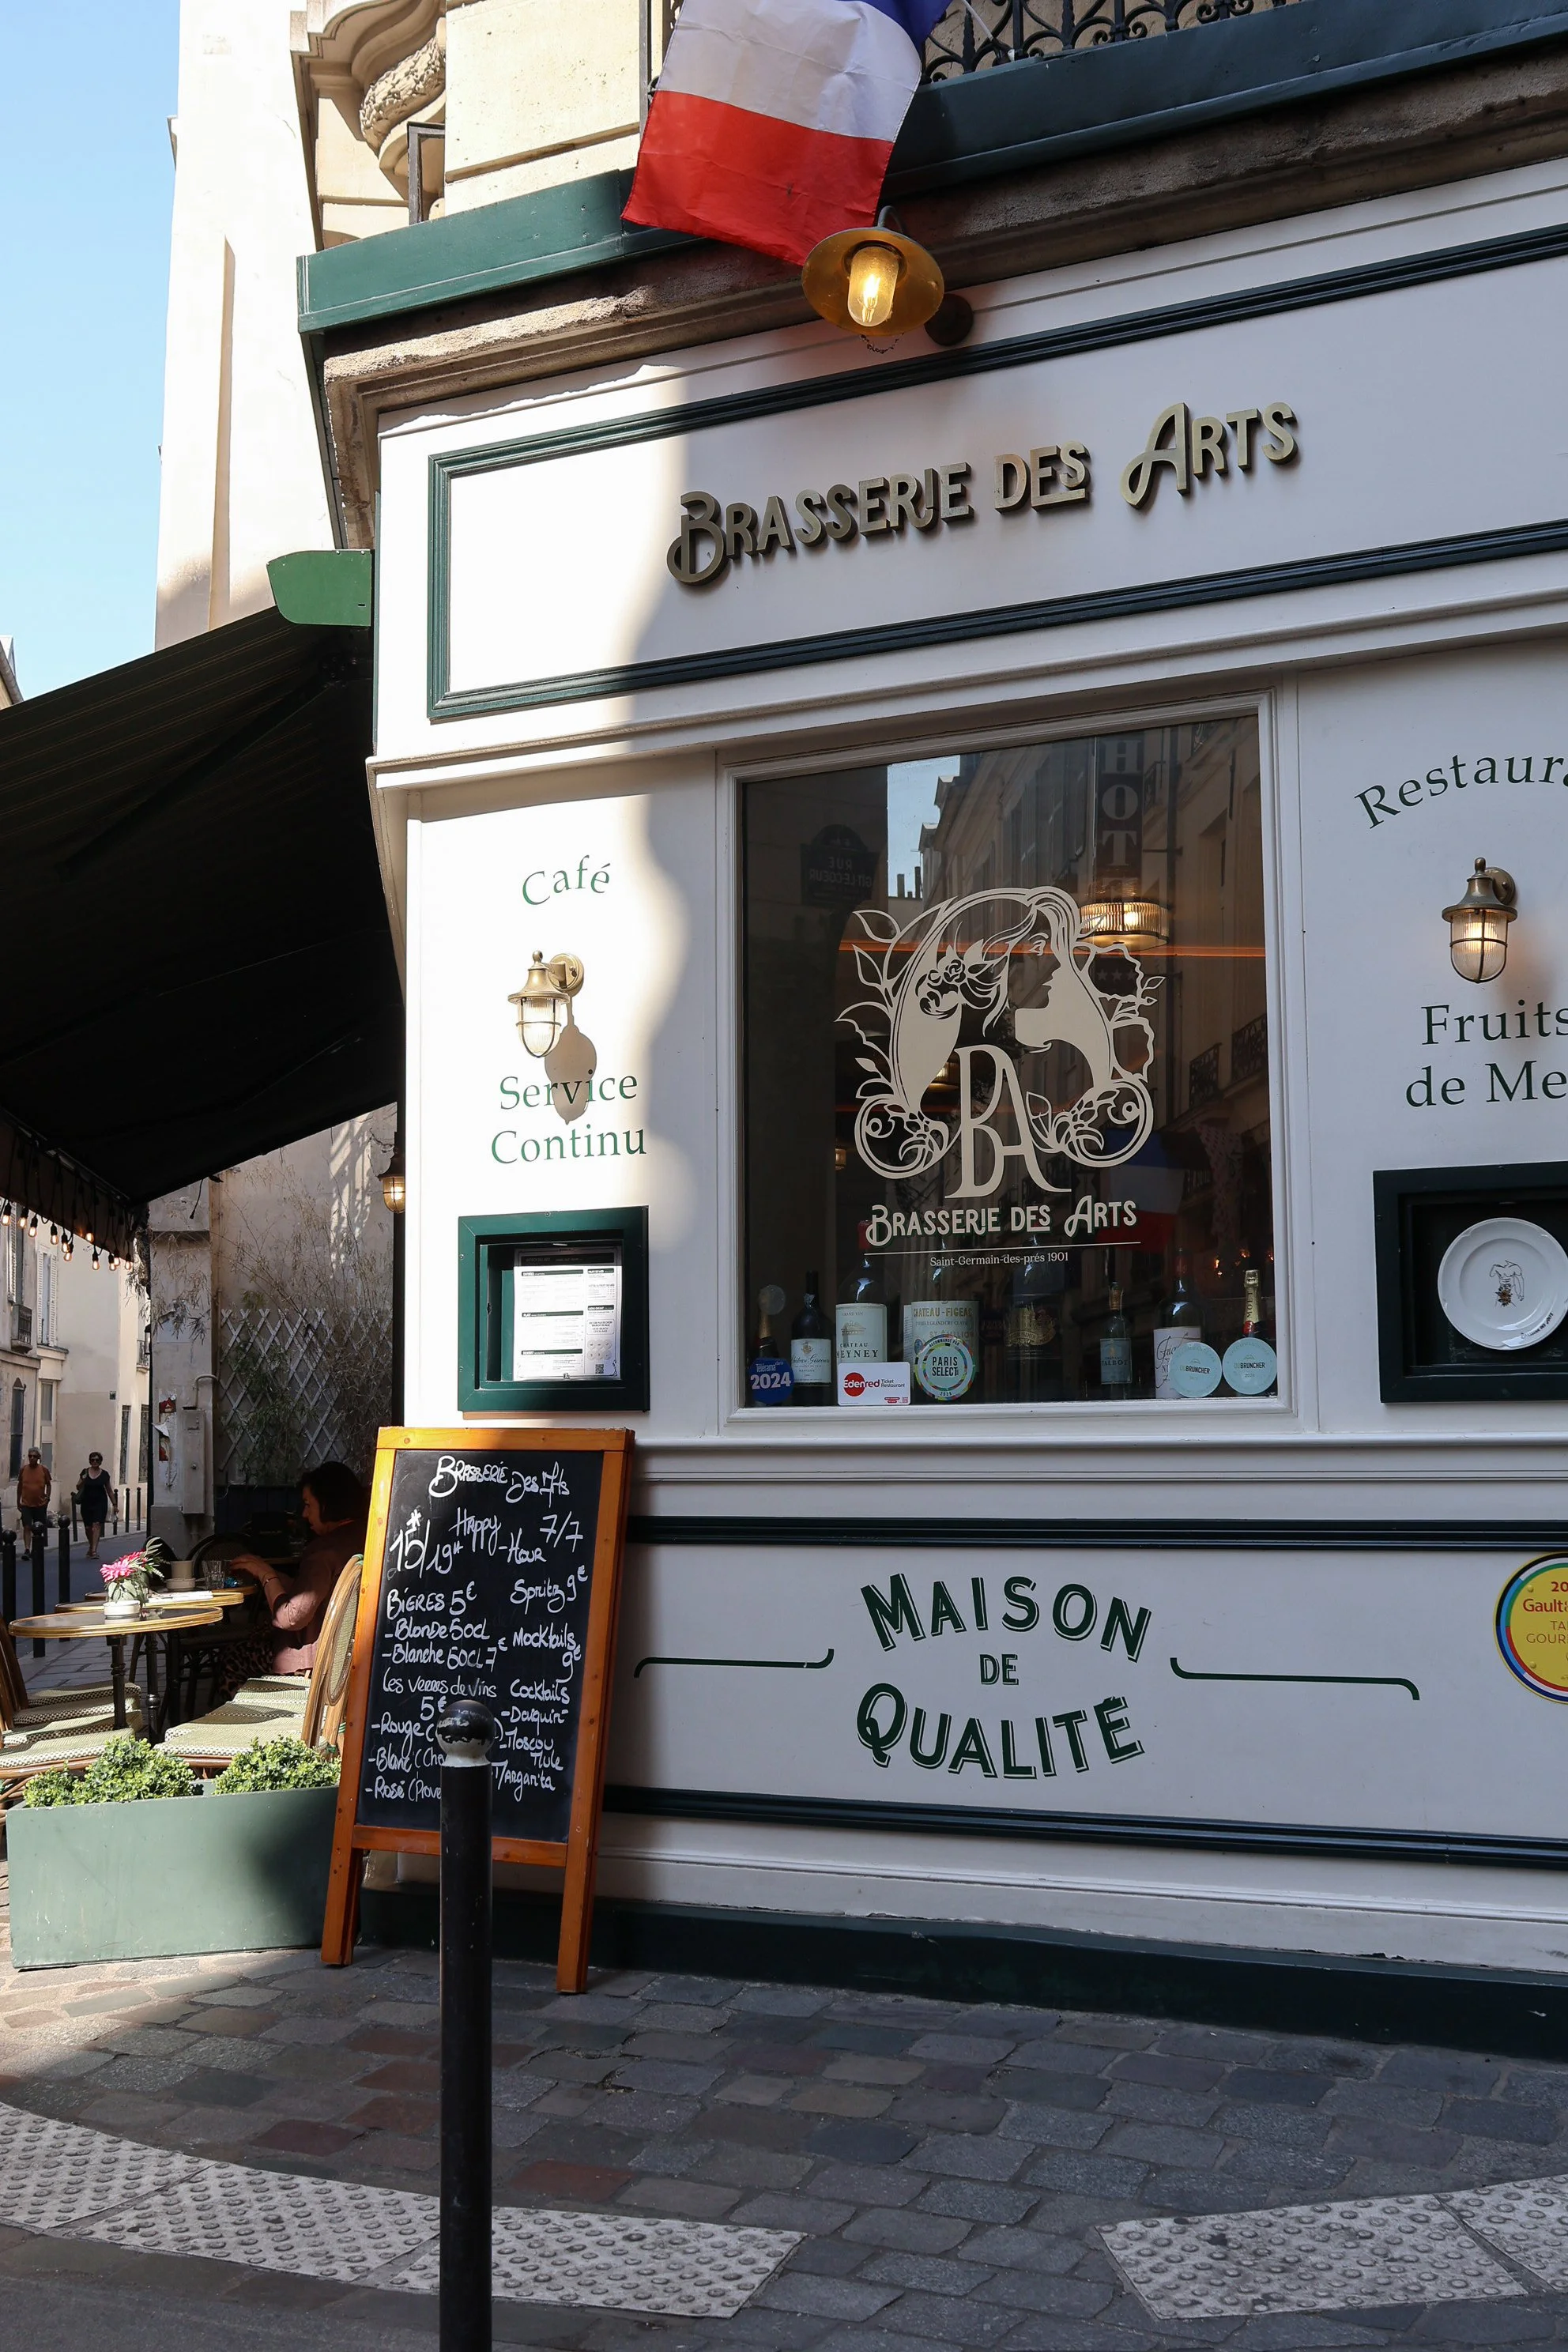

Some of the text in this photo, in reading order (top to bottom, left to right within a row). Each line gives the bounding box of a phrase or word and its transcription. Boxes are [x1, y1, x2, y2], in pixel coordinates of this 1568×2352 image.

[666, 401, 1298, 586] BRASSERIE DES ARTS
[1355, 753, 1568, 829] Restaur
[522, 854, 610, 905] Café
[1421, 999, 1568, 1045] Fruits
[499, 1069, 638, 1110] Service
[1405, 1061, 1567, 1107] de Me
[492, 1124, 646, 1164] Continu
[865, 1195, 1137, 1246] BRASSERIE DES ARTS
[929, 1252, 1069, 1268] Saint-Germain-des-prés 1901
[750, 1371, 792, 1390] 2024
[756, 1363, 776, 1373] Télérama
[932, 1356, 958, 1366] PARIS
[932, 1366, 958, 1377] SELECT
[843, 1379, 880, 1389] Edenred
[540, 1511, 584, 1552] 7/7
[860, 1573, 1152, 1663] MAISON
[1550, 1621, 1568, 1630] TA
[1525, 1634, 1568, 1644] GOUR
[979, 1653, 1019, 1686] DE
